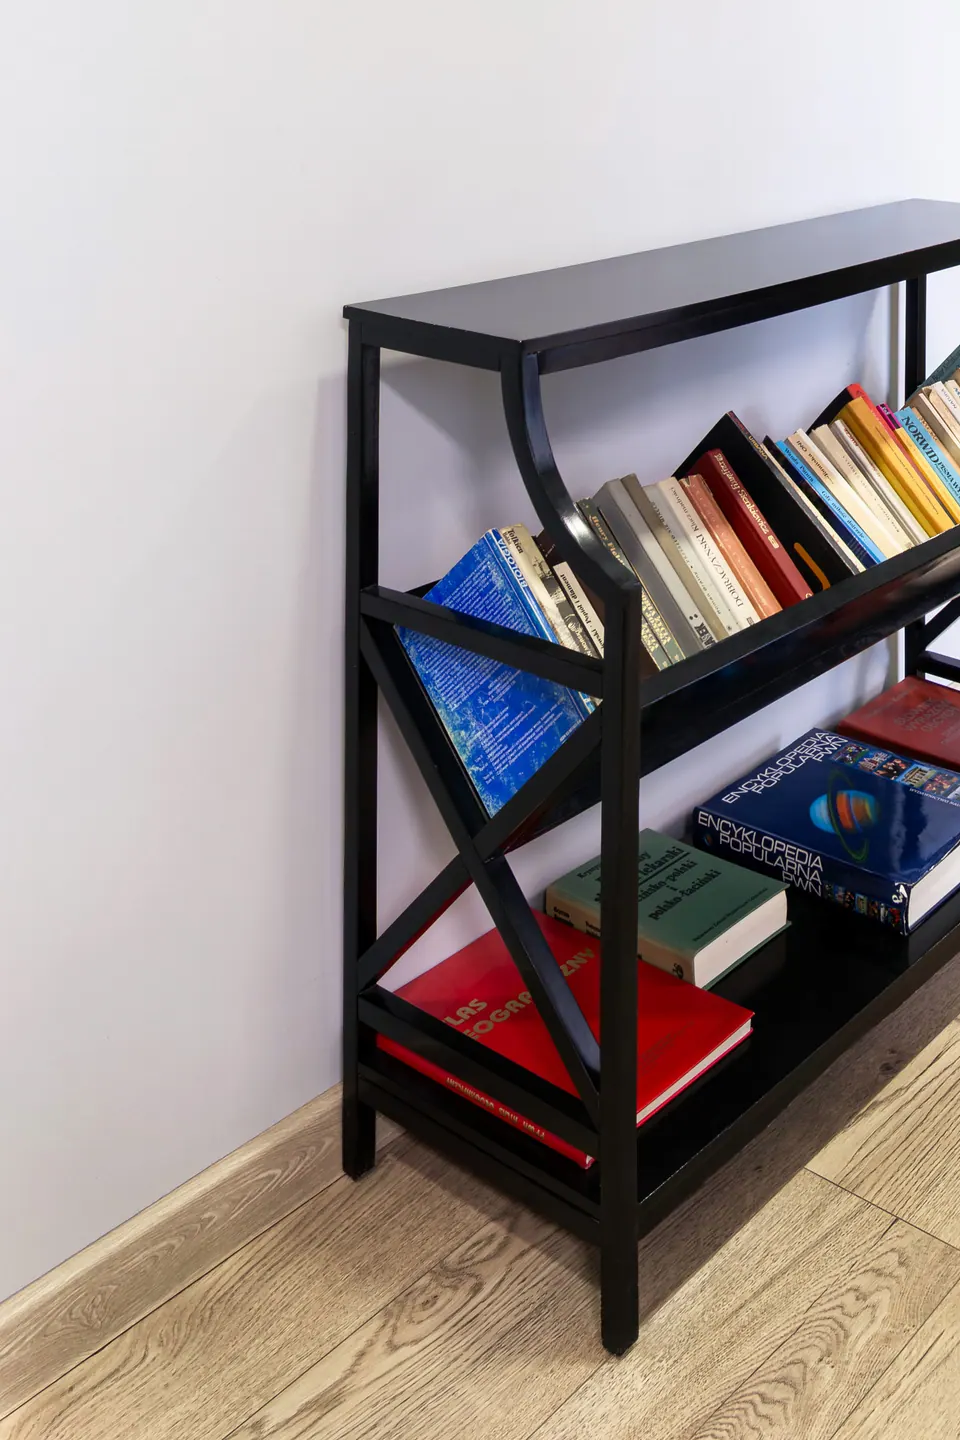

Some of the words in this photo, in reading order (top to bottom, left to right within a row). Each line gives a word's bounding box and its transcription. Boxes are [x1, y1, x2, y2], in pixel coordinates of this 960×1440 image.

[900, 414, 941, 464] NORWID
[936, 460, 954, 482] PISMA
[589, 513, 610, 541] Henry
[736, 486, 772, 535] Sienkiewicz
[495, 537, 529, 588] BIOLOGIA
[506, 528, 525, 554] Tolkien
[558, 572, 578, 600] diament
[721, 731, 829, 805] ENCYKLOPEDIA
[753, 734, 840, 795] POPULARNA
[814, 736, 850, 762] PWN
[697, 811, 824, 872] ENCYKLOPEDIA
[718, 832, 823, 886] POPULARNA
[781, 870, 822, 898] PWN
[444, 993, 488, 1030] LAS
